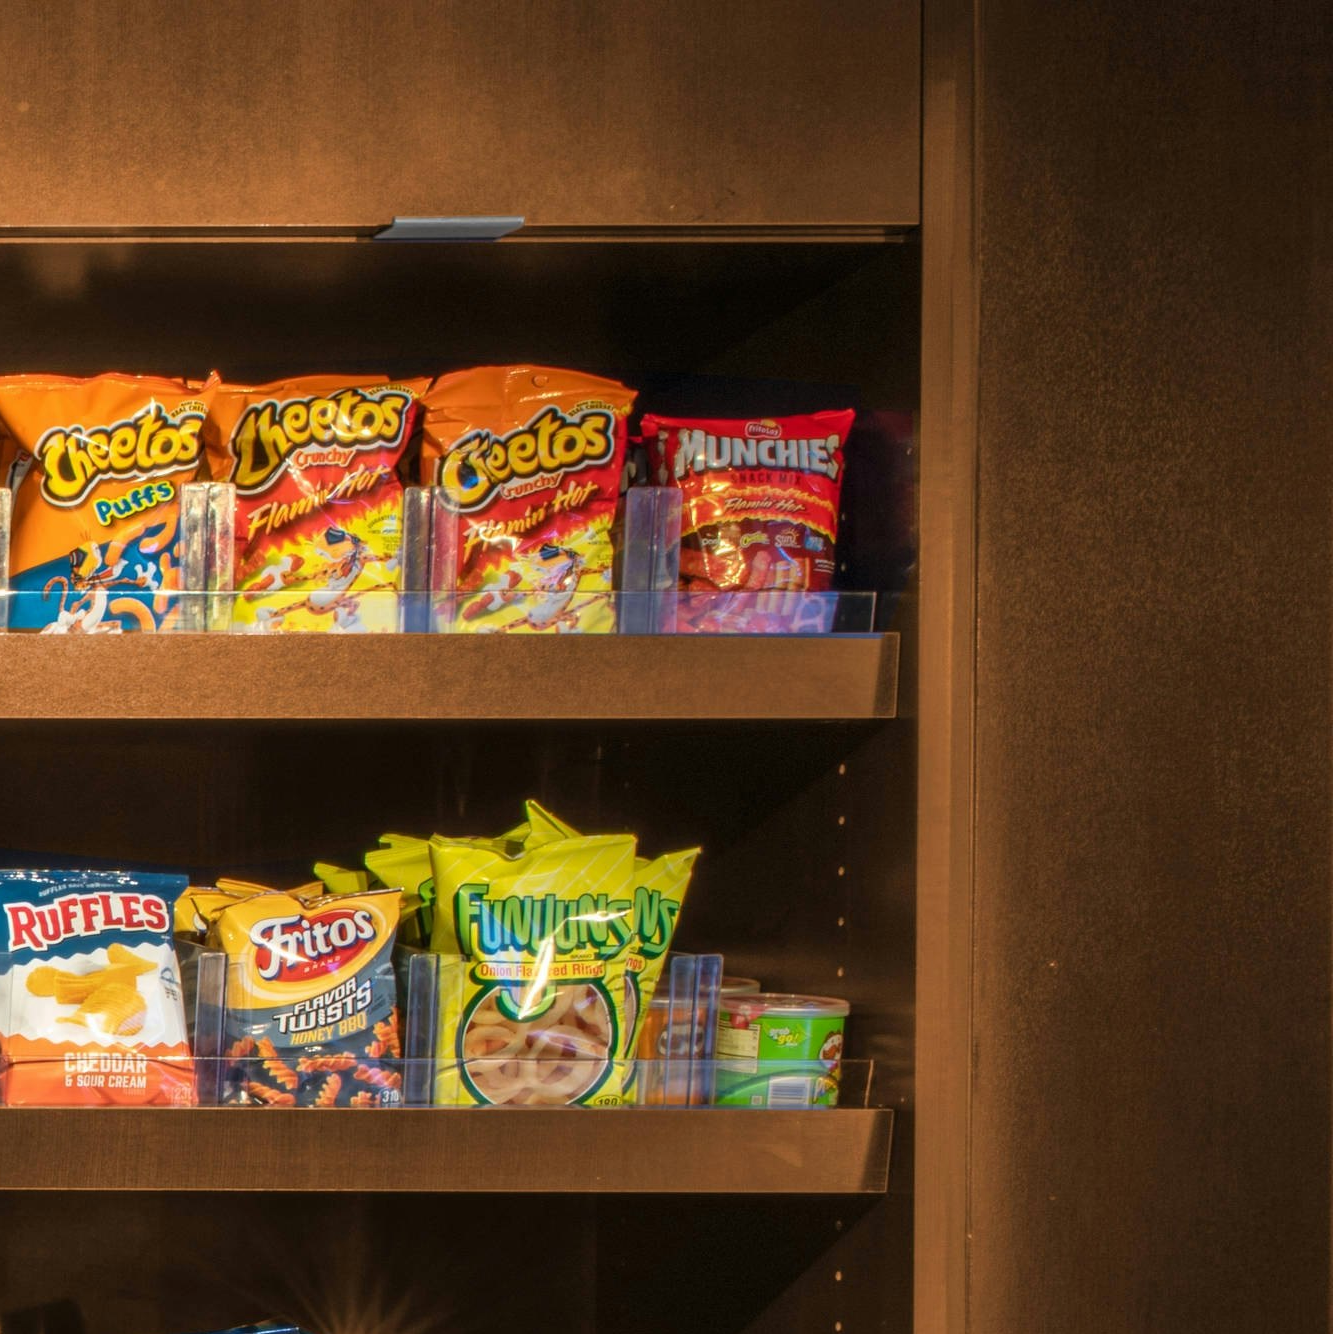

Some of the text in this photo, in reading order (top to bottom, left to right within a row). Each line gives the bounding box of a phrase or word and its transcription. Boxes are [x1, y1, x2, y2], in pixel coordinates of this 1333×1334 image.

[39, 408, 205, 502] Cheetos
[234, 390, 411, 492] Cheetos
[294, 448, 354, 468] Crunchy
[440, 408, 614, 506] Cheetos
[674, 429, 840, 479] MUNCHIES
[95, 481, 173, 524] Puffs
[5, 893, 169, 951] RUFFLES
[251, 908, 375, 979] Fritos
[480, 963, 512, 978] Onion
[273, 979, 374, 1034] TWISTS
[294, 979, 357, 1013] FLAVOR
[290, 1026, 333, 1047] HONEY
[63, 1052, 147, 1073] CHEDDAR
[76, 1074, 147, 1089] SOUR CREAM
